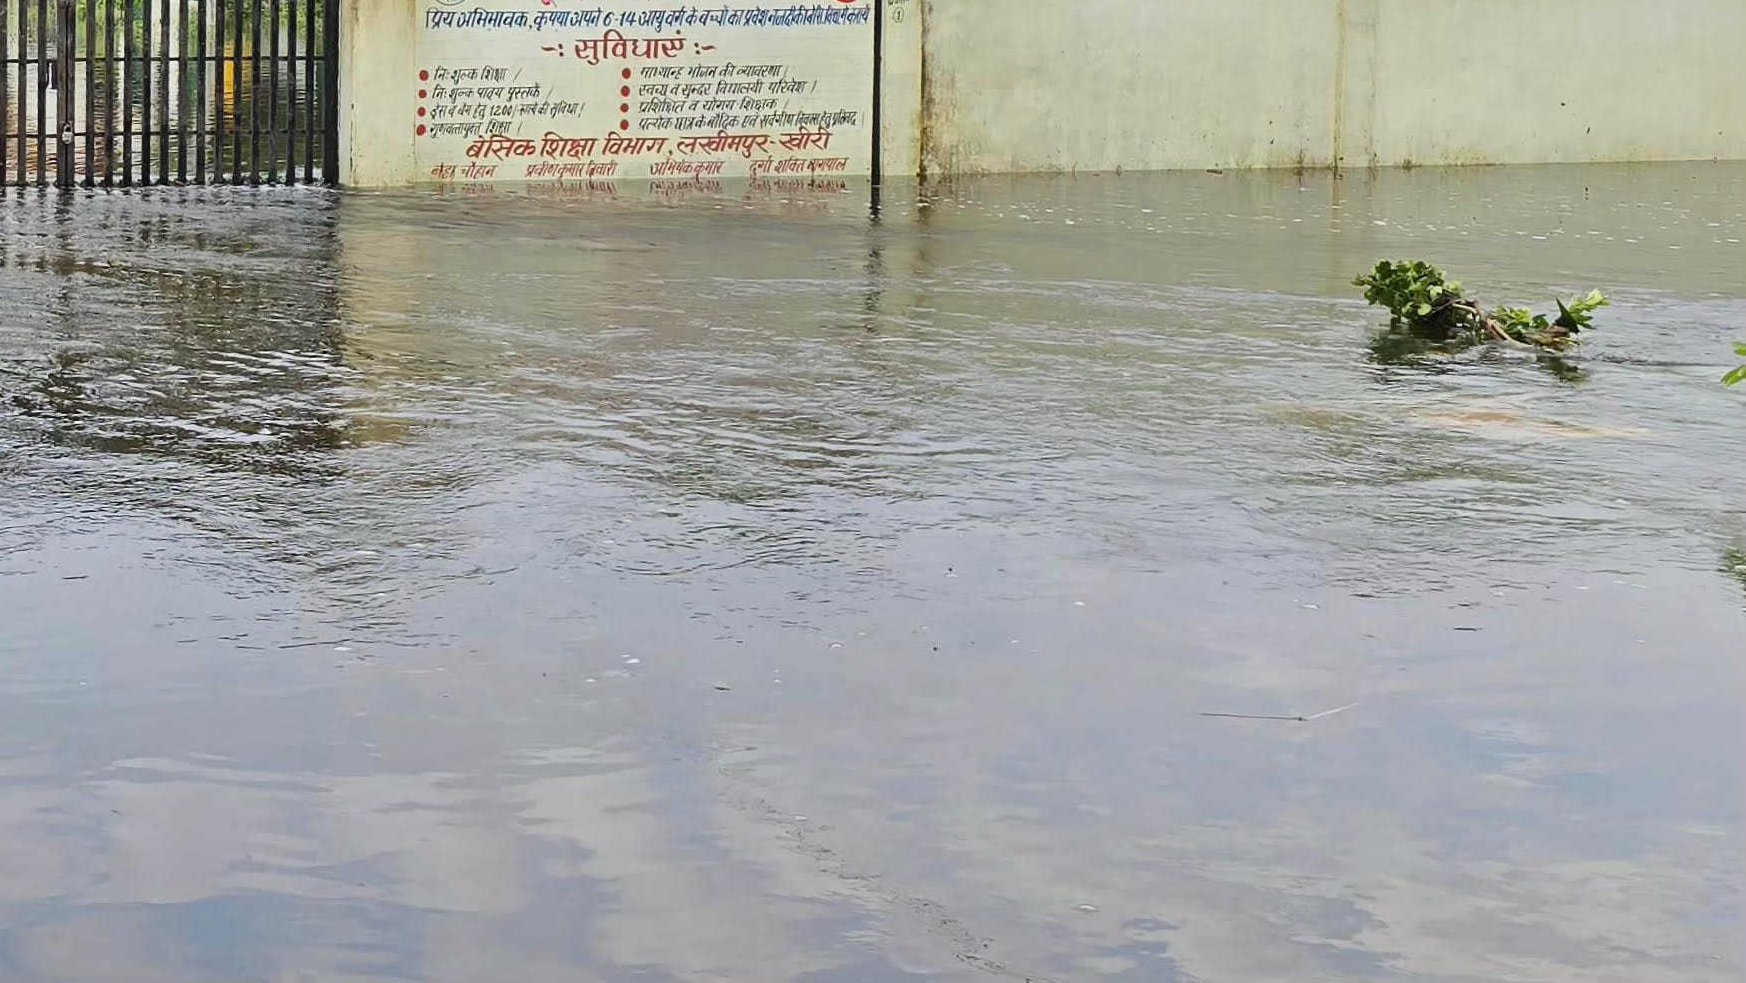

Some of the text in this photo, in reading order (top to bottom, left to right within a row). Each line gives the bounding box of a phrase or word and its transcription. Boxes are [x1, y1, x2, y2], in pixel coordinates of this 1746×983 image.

[426, 7, 456, 31] प्रिय
[533, 9, 570, 32] कृपया
[570, 7, 603, 28] अपने
[638, 10, 666, 33] आयु
[666, 6, 687, 27] वर्ग
[686, 6, 698, 27] के
[728, 8, 743, 26] का
[480, 66, 508, 82] शिक्षा
[688, 63, 718, 78] भोजन
[719, 62, 736, 77] की
[670, 83, 680, 95] व
[682, 83, 713, 98] सुन्दर
[768, 77, 808, 95] परिवेश
[472, 103, 486, 118] हेतु
[639, 97, 686, 113] प्रशिक्षित
[688, 100, 699, 111] व
[739, 96, 778, 111] शिक्षक
[485, 119, 512, 135] शिक्षा
[694, 114, 707, 129] के
[466, 133, 536, 161] बेसिक
[540, 132, 598, 160] शिक्षा
[460, 161, 497, 179] चौहान
[650, 158, 693, 175] अभिषेक
